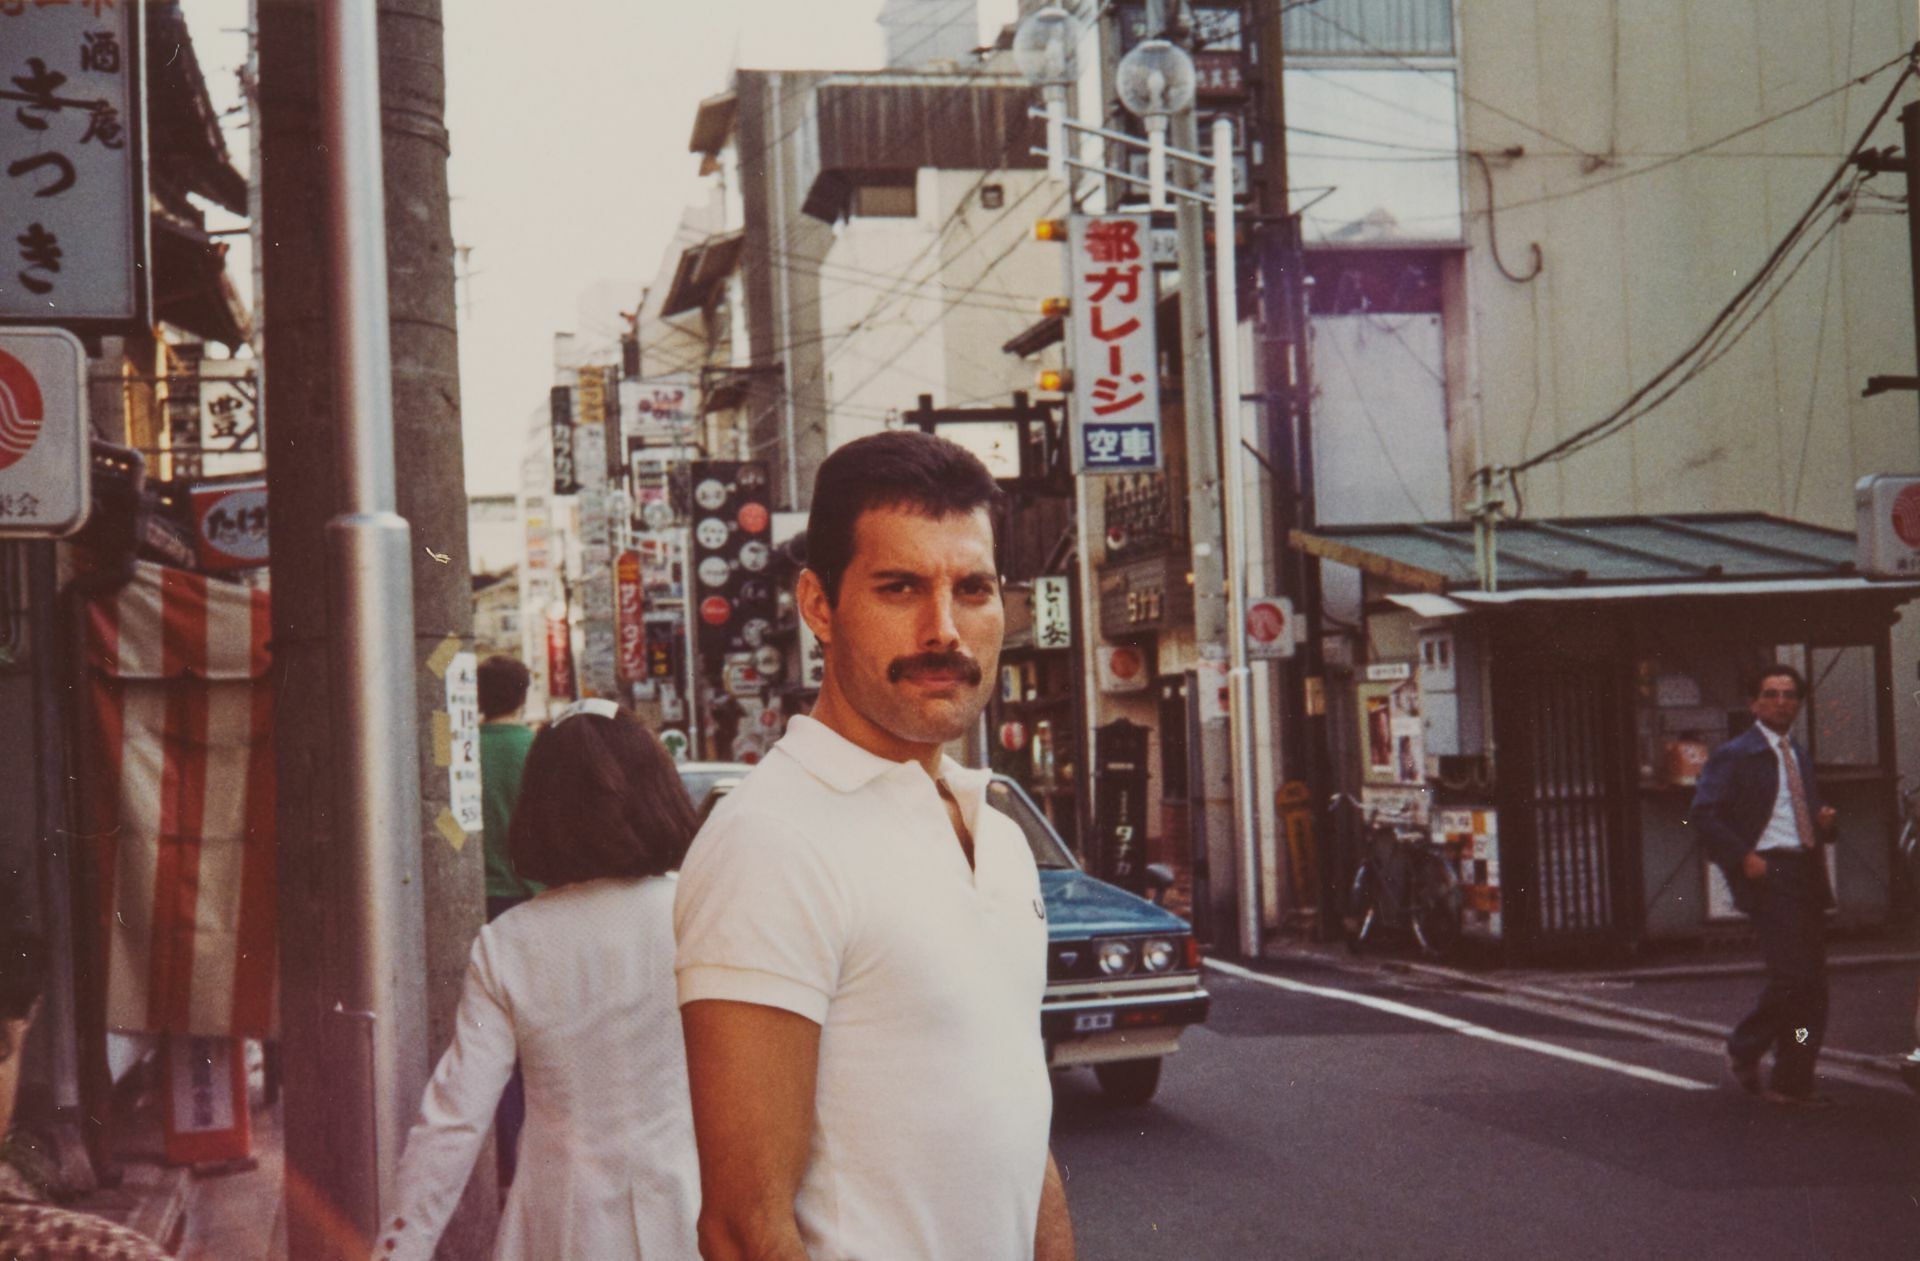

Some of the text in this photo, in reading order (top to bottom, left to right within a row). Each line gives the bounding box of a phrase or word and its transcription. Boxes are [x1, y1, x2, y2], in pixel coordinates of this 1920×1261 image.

[8, 56, 76, 294] さつき
[1086, 427, 1152, 462] 空車
